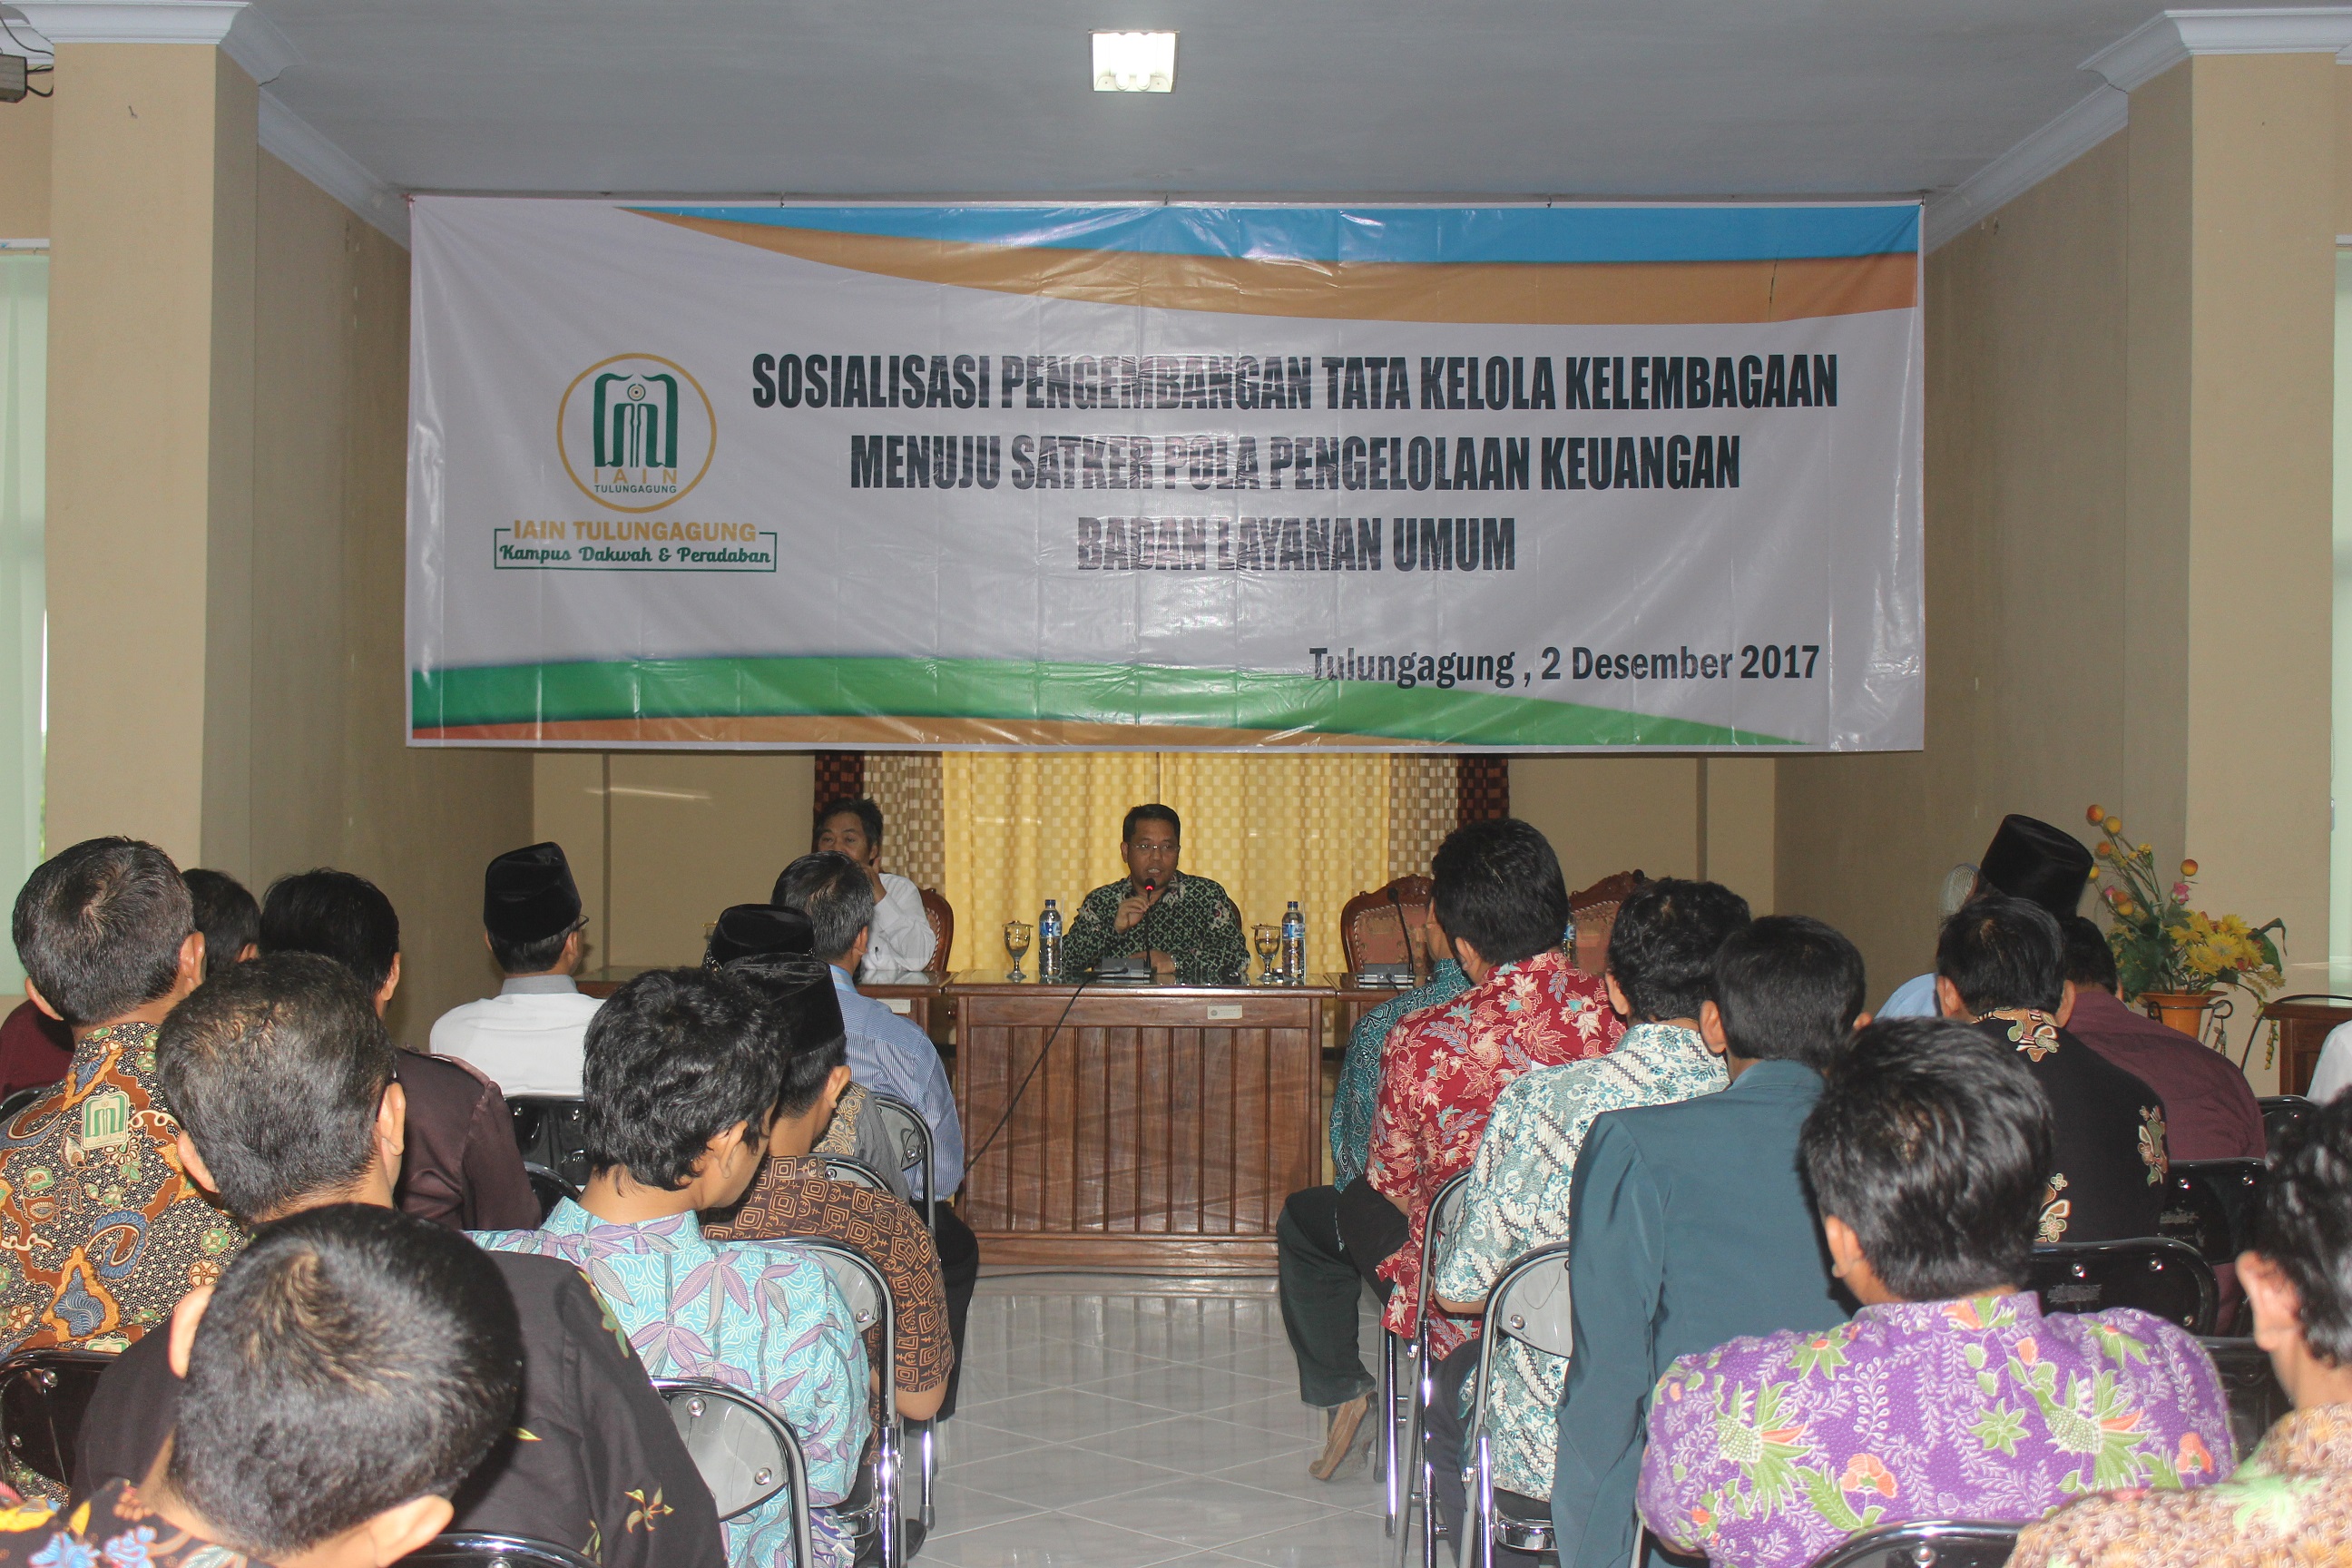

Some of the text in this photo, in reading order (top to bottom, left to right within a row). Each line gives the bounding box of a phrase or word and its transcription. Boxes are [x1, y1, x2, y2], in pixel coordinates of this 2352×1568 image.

[752, 353, 1838, 410] SOSIALISASI PENGEMBANGAN TATA KELOLA KELEMBAGAAN
[593, 468, 678, 485] IAIN
[851, 435, 1740, 491] MENUJU SATKER POLA PENGELOLAAN KEUANGAN
[594, 485, 677, 495] TULUNGAGUNG
[514, 520, 757, 543] IAIN TULUNGAGUNG
[1077, 516, 1515, 572] BADAN LAYANAN UMUM
[499, 544, 572, 564] Kampus
[578, 546, 652, 563] Dakwah
[677, 547, 771, 564] Peradaban
[1541, 646, 1562, 681] 2
[1572, 645, 1733, 681] Desember
[1740, 644, 1820, 680] 2017
